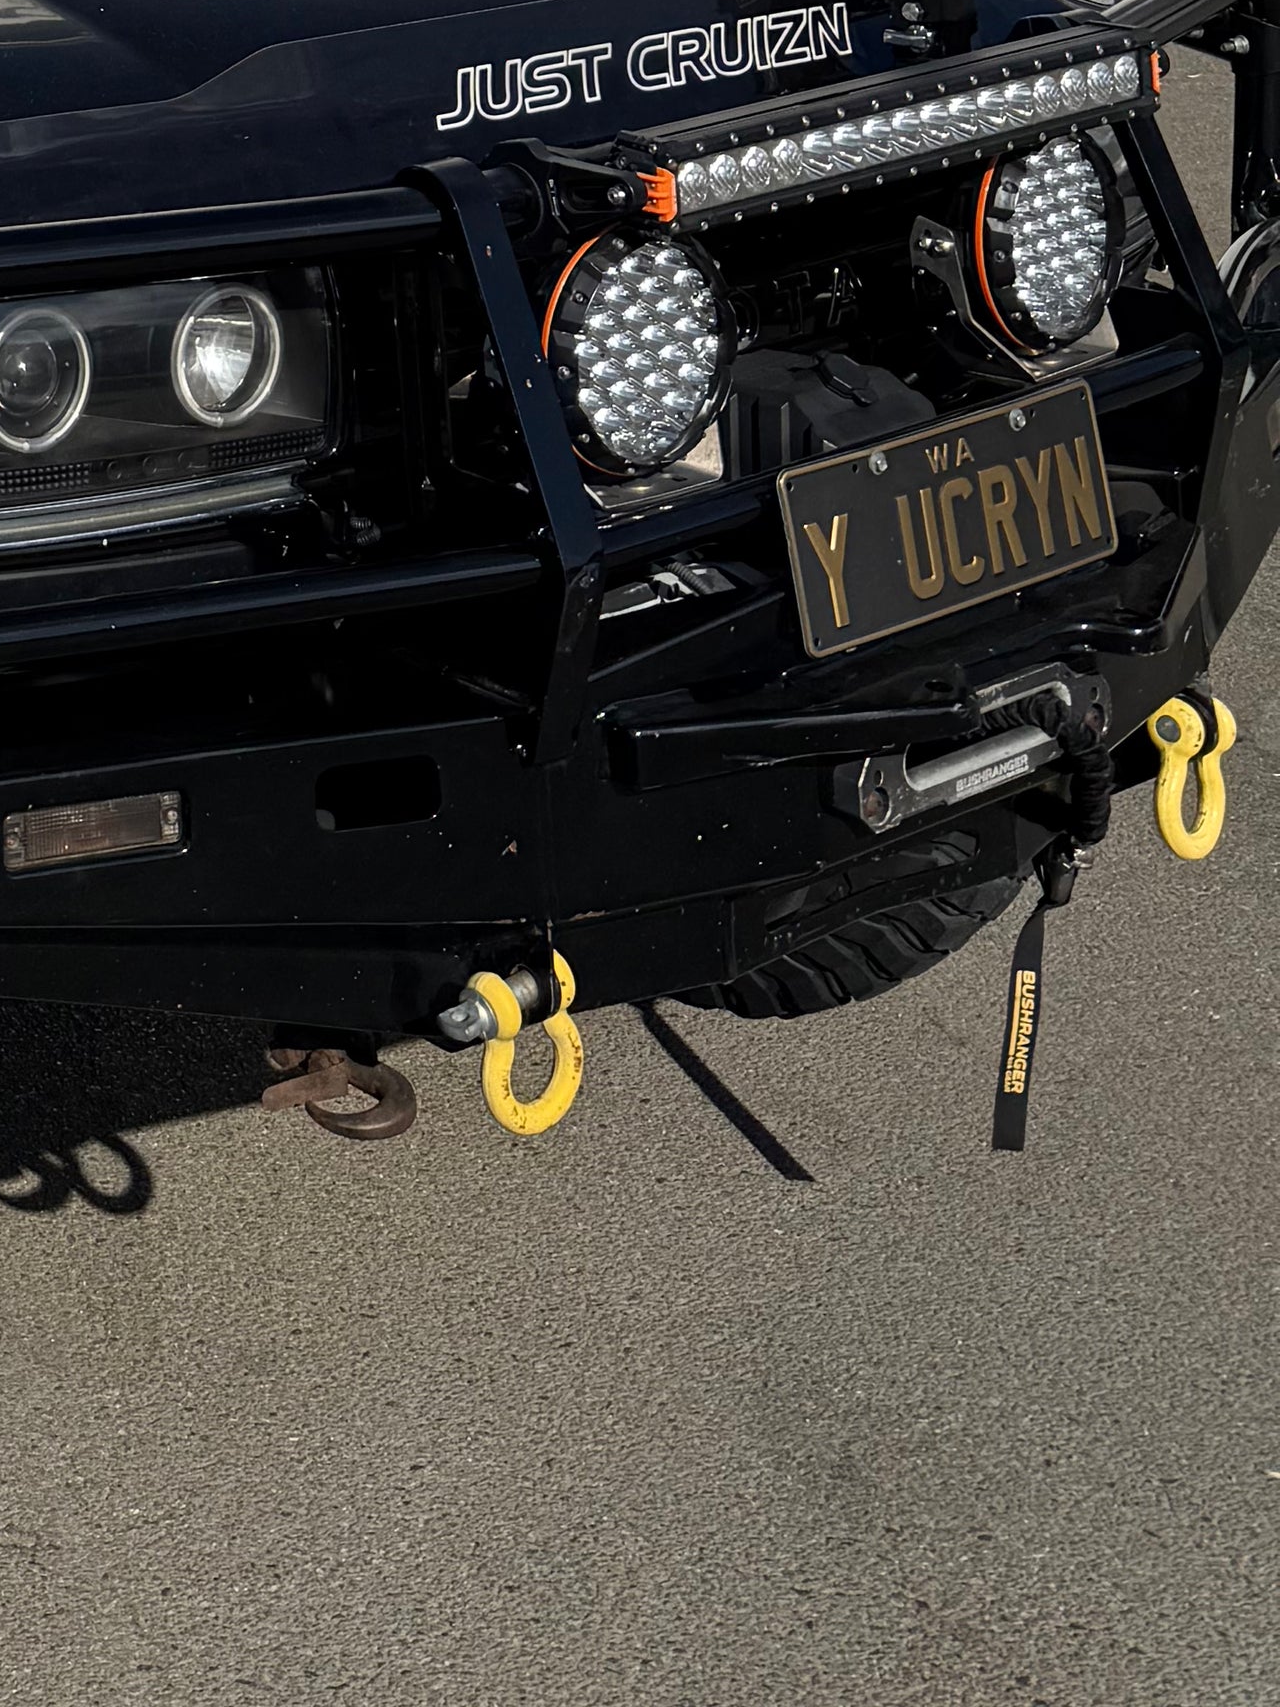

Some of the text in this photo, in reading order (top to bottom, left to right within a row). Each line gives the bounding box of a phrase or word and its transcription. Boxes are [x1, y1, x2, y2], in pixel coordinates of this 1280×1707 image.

[435, 2, 853, 131] JUST CRUIZN
[925, 437, 975, 474] WA
[803, 435, 1103, 628] Y UCRYN
[955, 753, 1029, 792] BUSHRANGER
[1011, 970, 1036, 1094] BUSHRANGER
